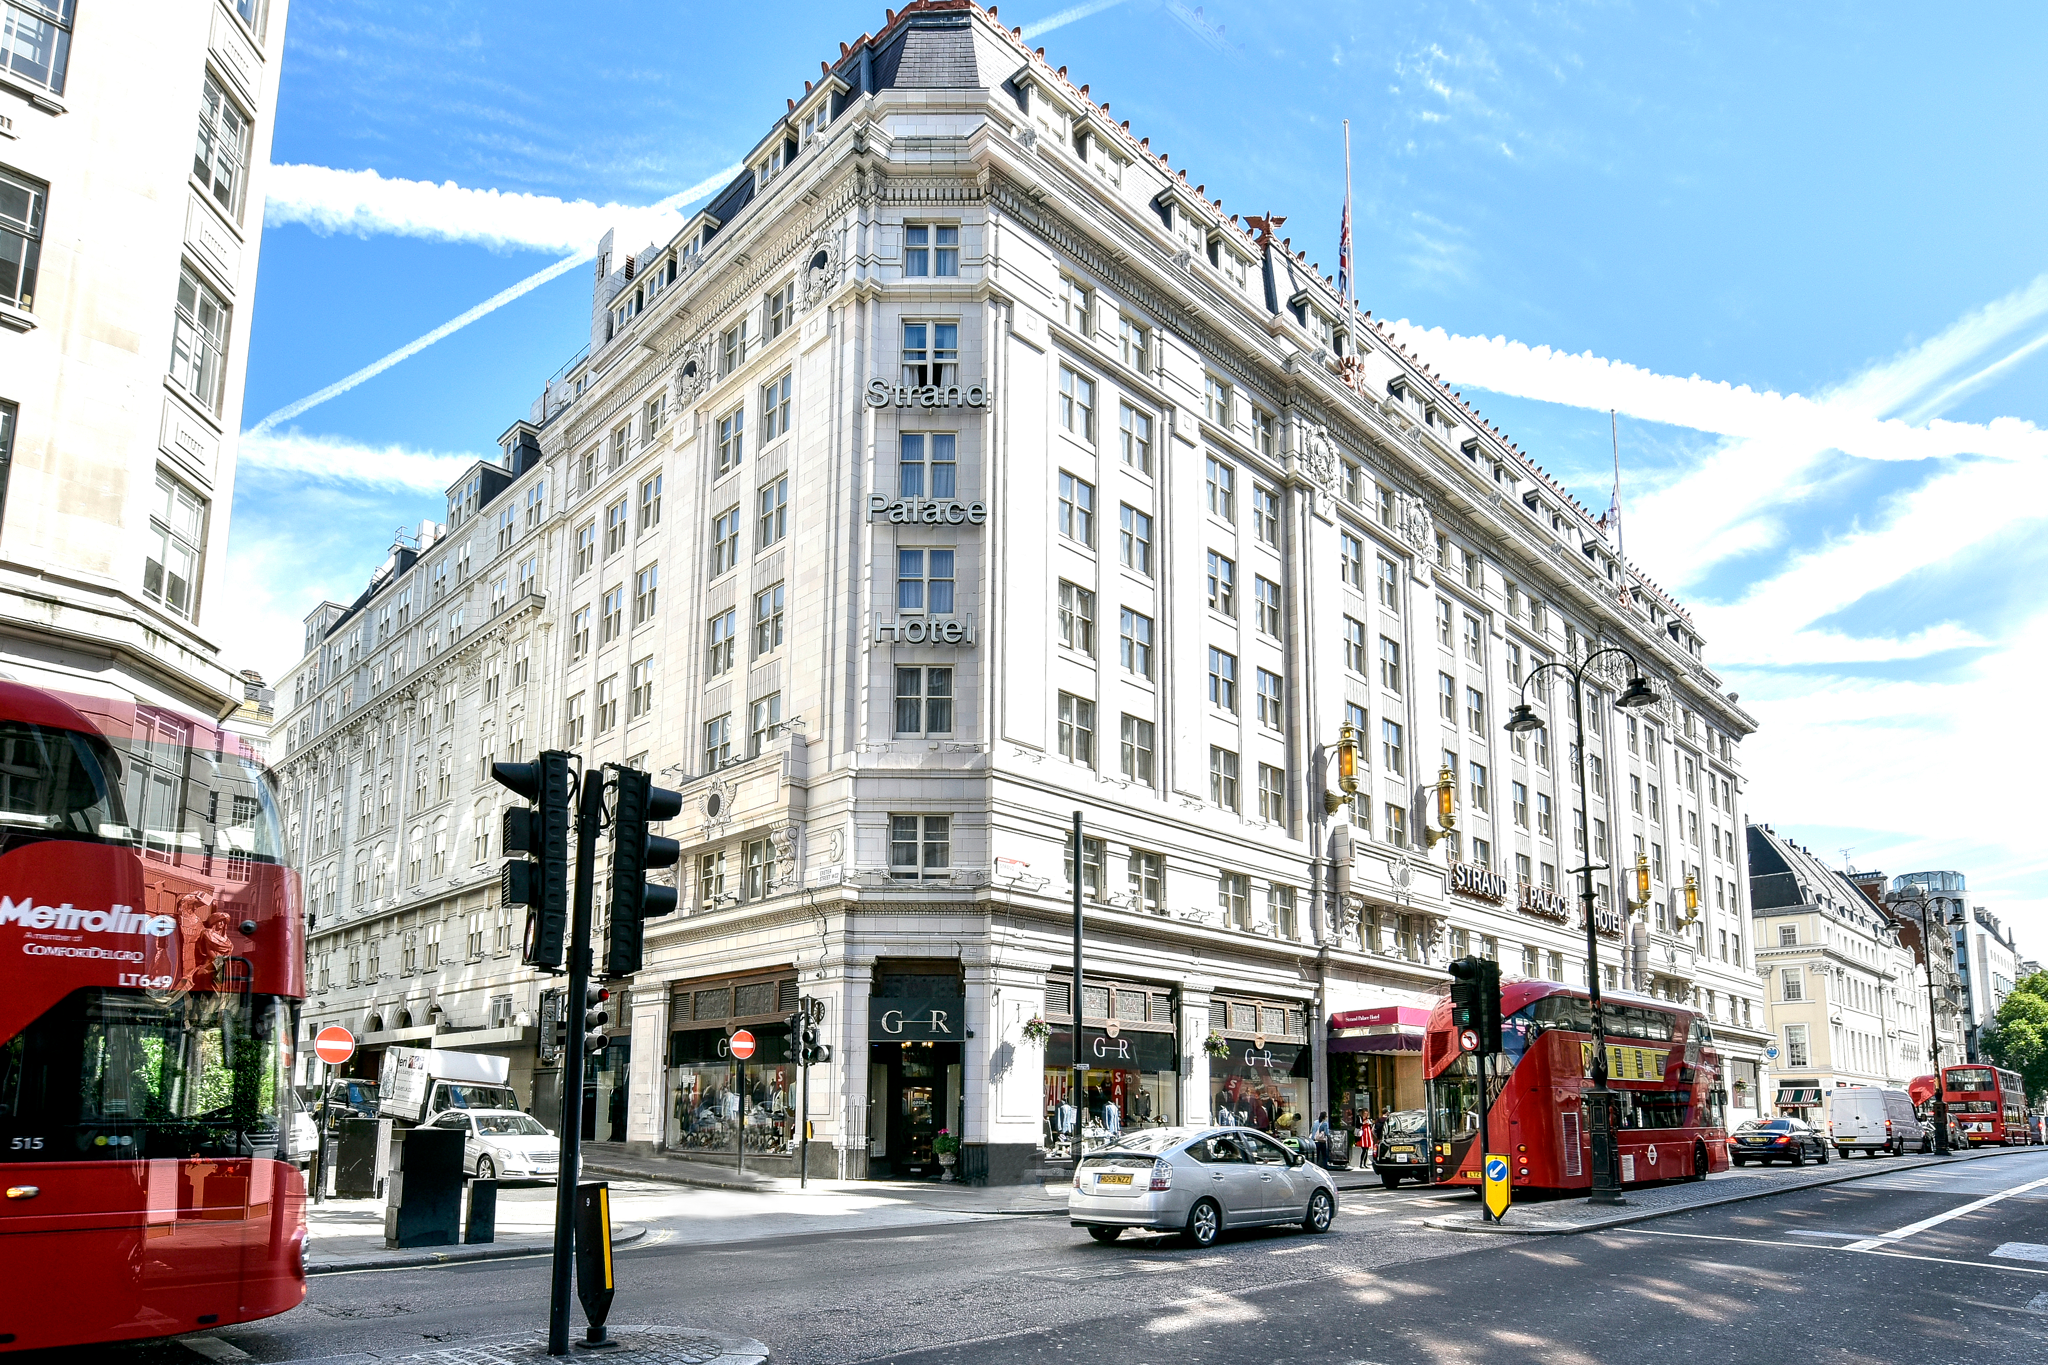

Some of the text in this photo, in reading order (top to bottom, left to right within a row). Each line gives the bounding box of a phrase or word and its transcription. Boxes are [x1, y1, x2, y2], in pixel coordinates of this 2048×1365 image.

[865, 377, 987, 408] Strand
[866, 493, 988, 524] Palace
[874, 611, 974, 643] Hotel
[1455, 862, 1624, 934] STRAND PALACE HOTEL
[0, 895, 177, 937] Metroline
[118, 973, 173, 988] LT649
[10, 1137, 45, 1150] 515
[585, 1197, 591, 1207] 9
